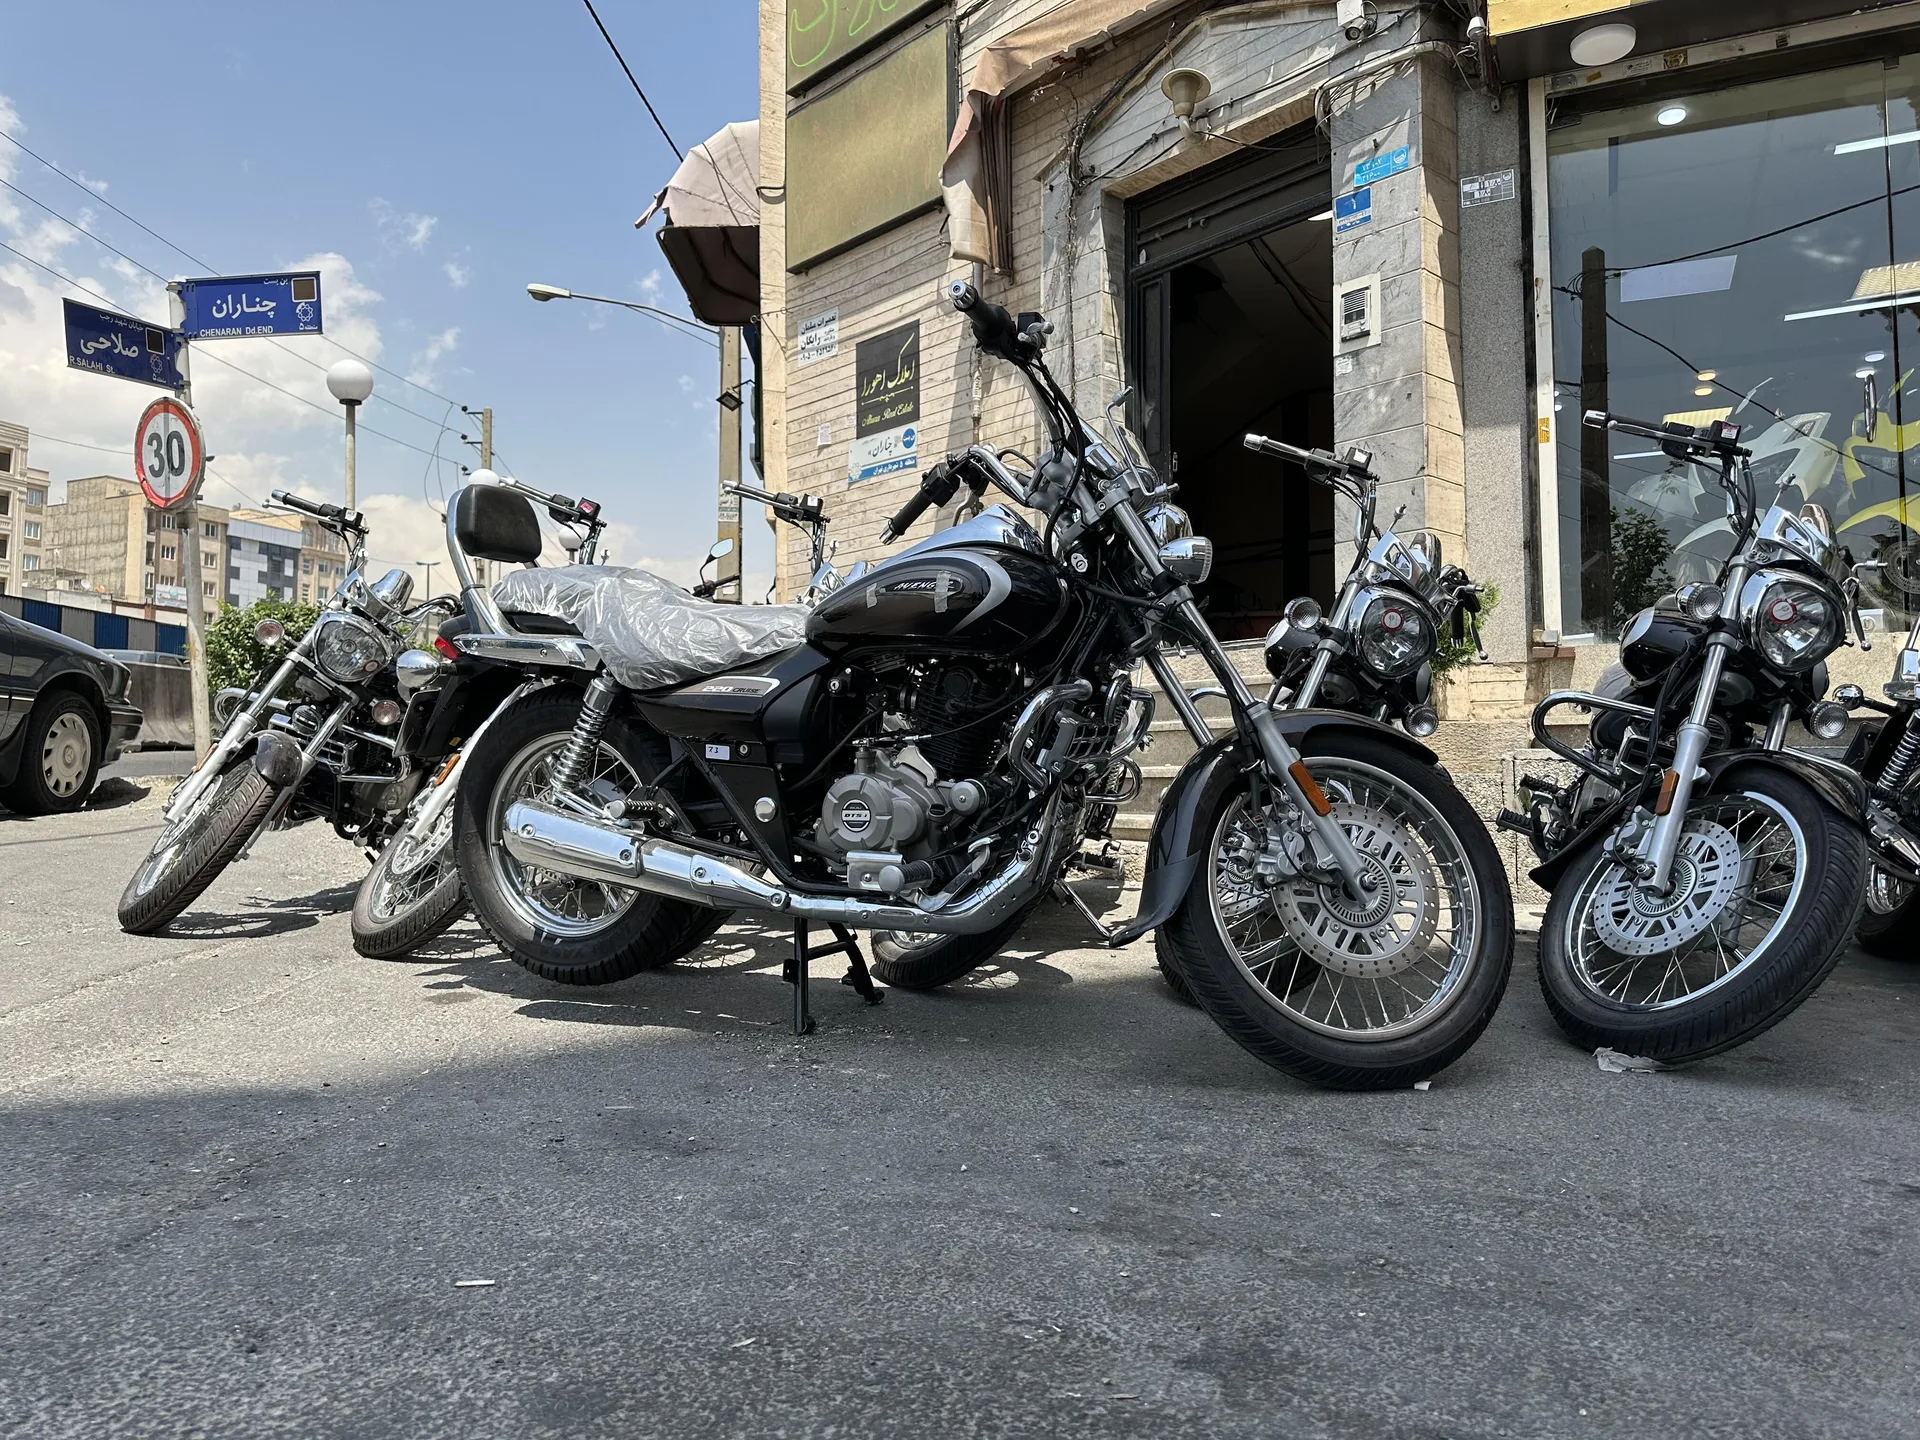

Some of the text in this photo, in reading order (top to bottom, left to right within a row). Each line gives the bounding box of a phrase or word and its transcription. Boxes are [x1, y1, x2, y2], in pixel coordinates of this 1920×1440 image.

[263, 278, 279, 286] بست
[212, 293, 277, 319] چناران
[99, 314, 144, 332] خیابان شهید رجب
[200, 327, 242, 337] CHENARAN
[80, 332, 139, 358] صلاحی
[800, 333, 821, 351] رایگان
[69, 355, 116, 374] R.SALAHI St.
[861, 332, 915, 397] املاک اهورا
[147, 430, 186, 478] 30
[893, 581, 956, 591] AVENG
